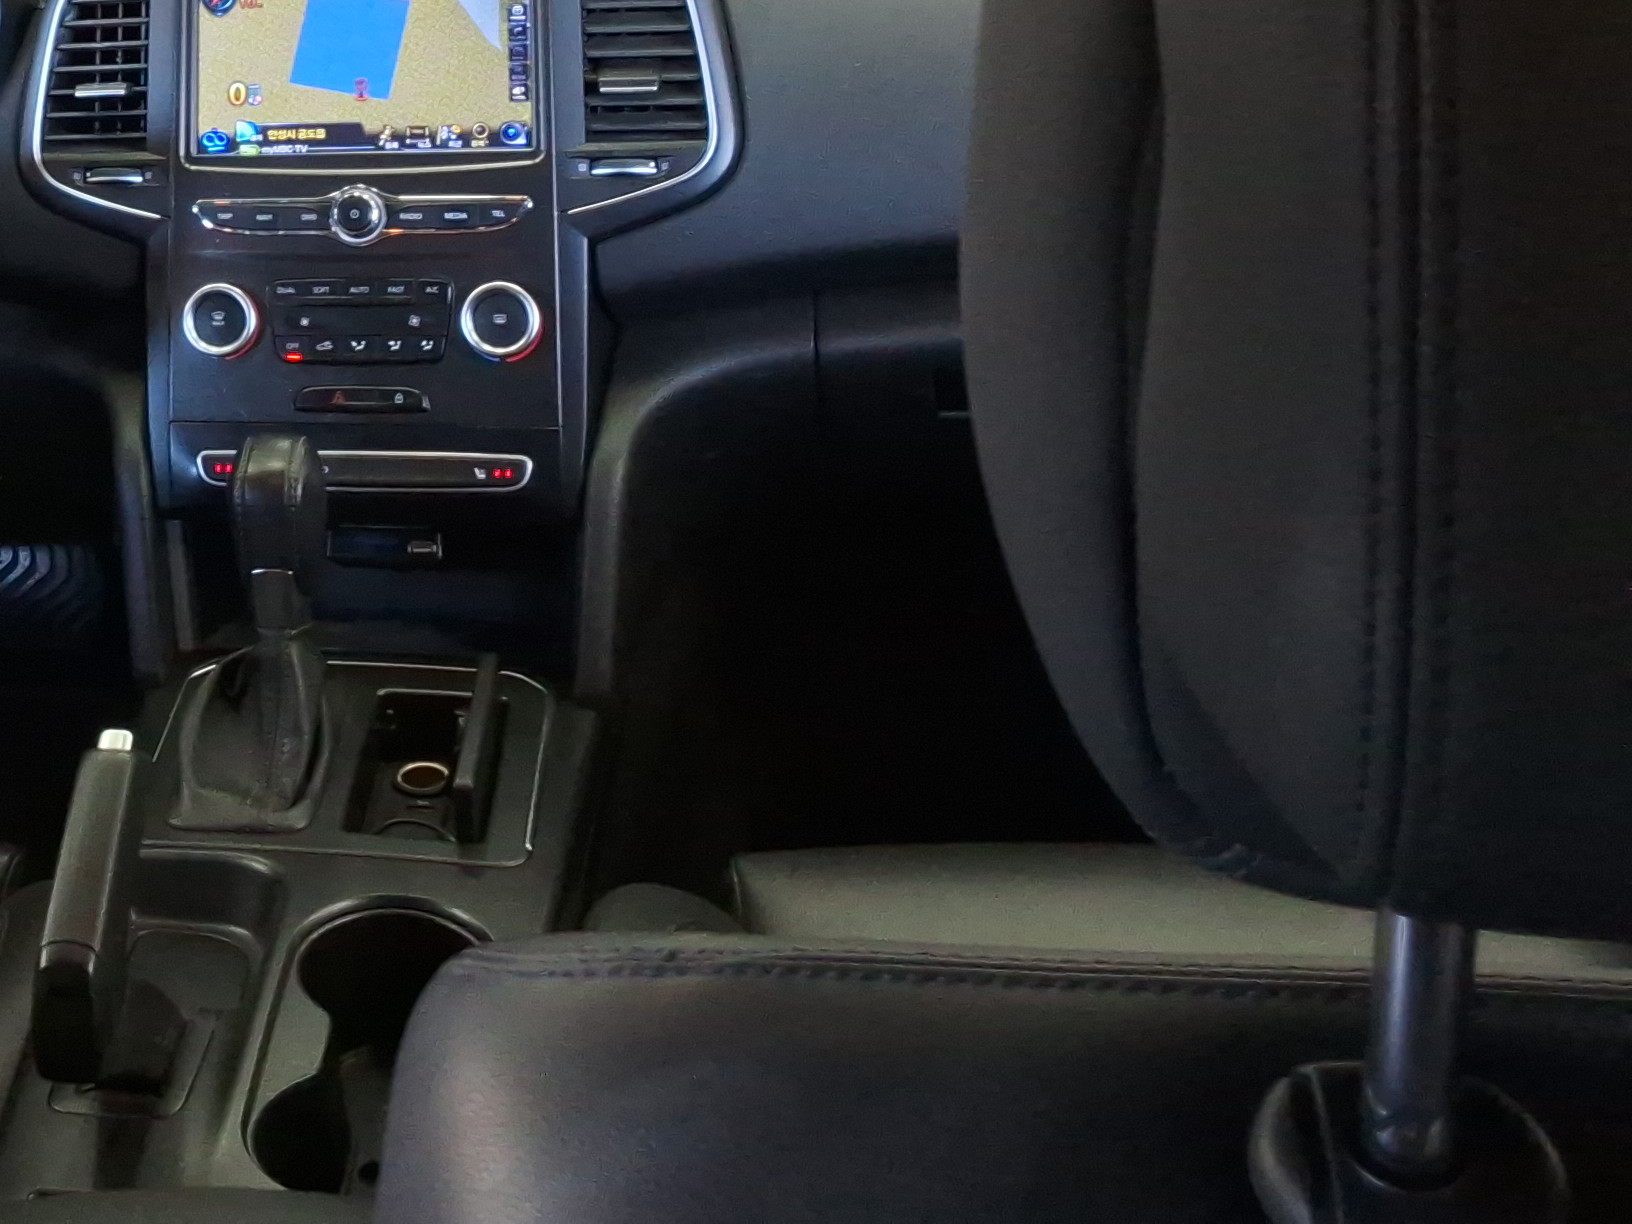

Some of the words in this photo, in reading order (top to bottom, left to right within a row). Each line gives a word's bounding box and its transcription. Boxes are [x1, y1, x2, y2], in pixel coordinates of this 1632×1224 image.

[348, 285, 370, 294] AUTO
[387, 285, 405, 294] FAST
[286, 341, 300, 350] OFF
